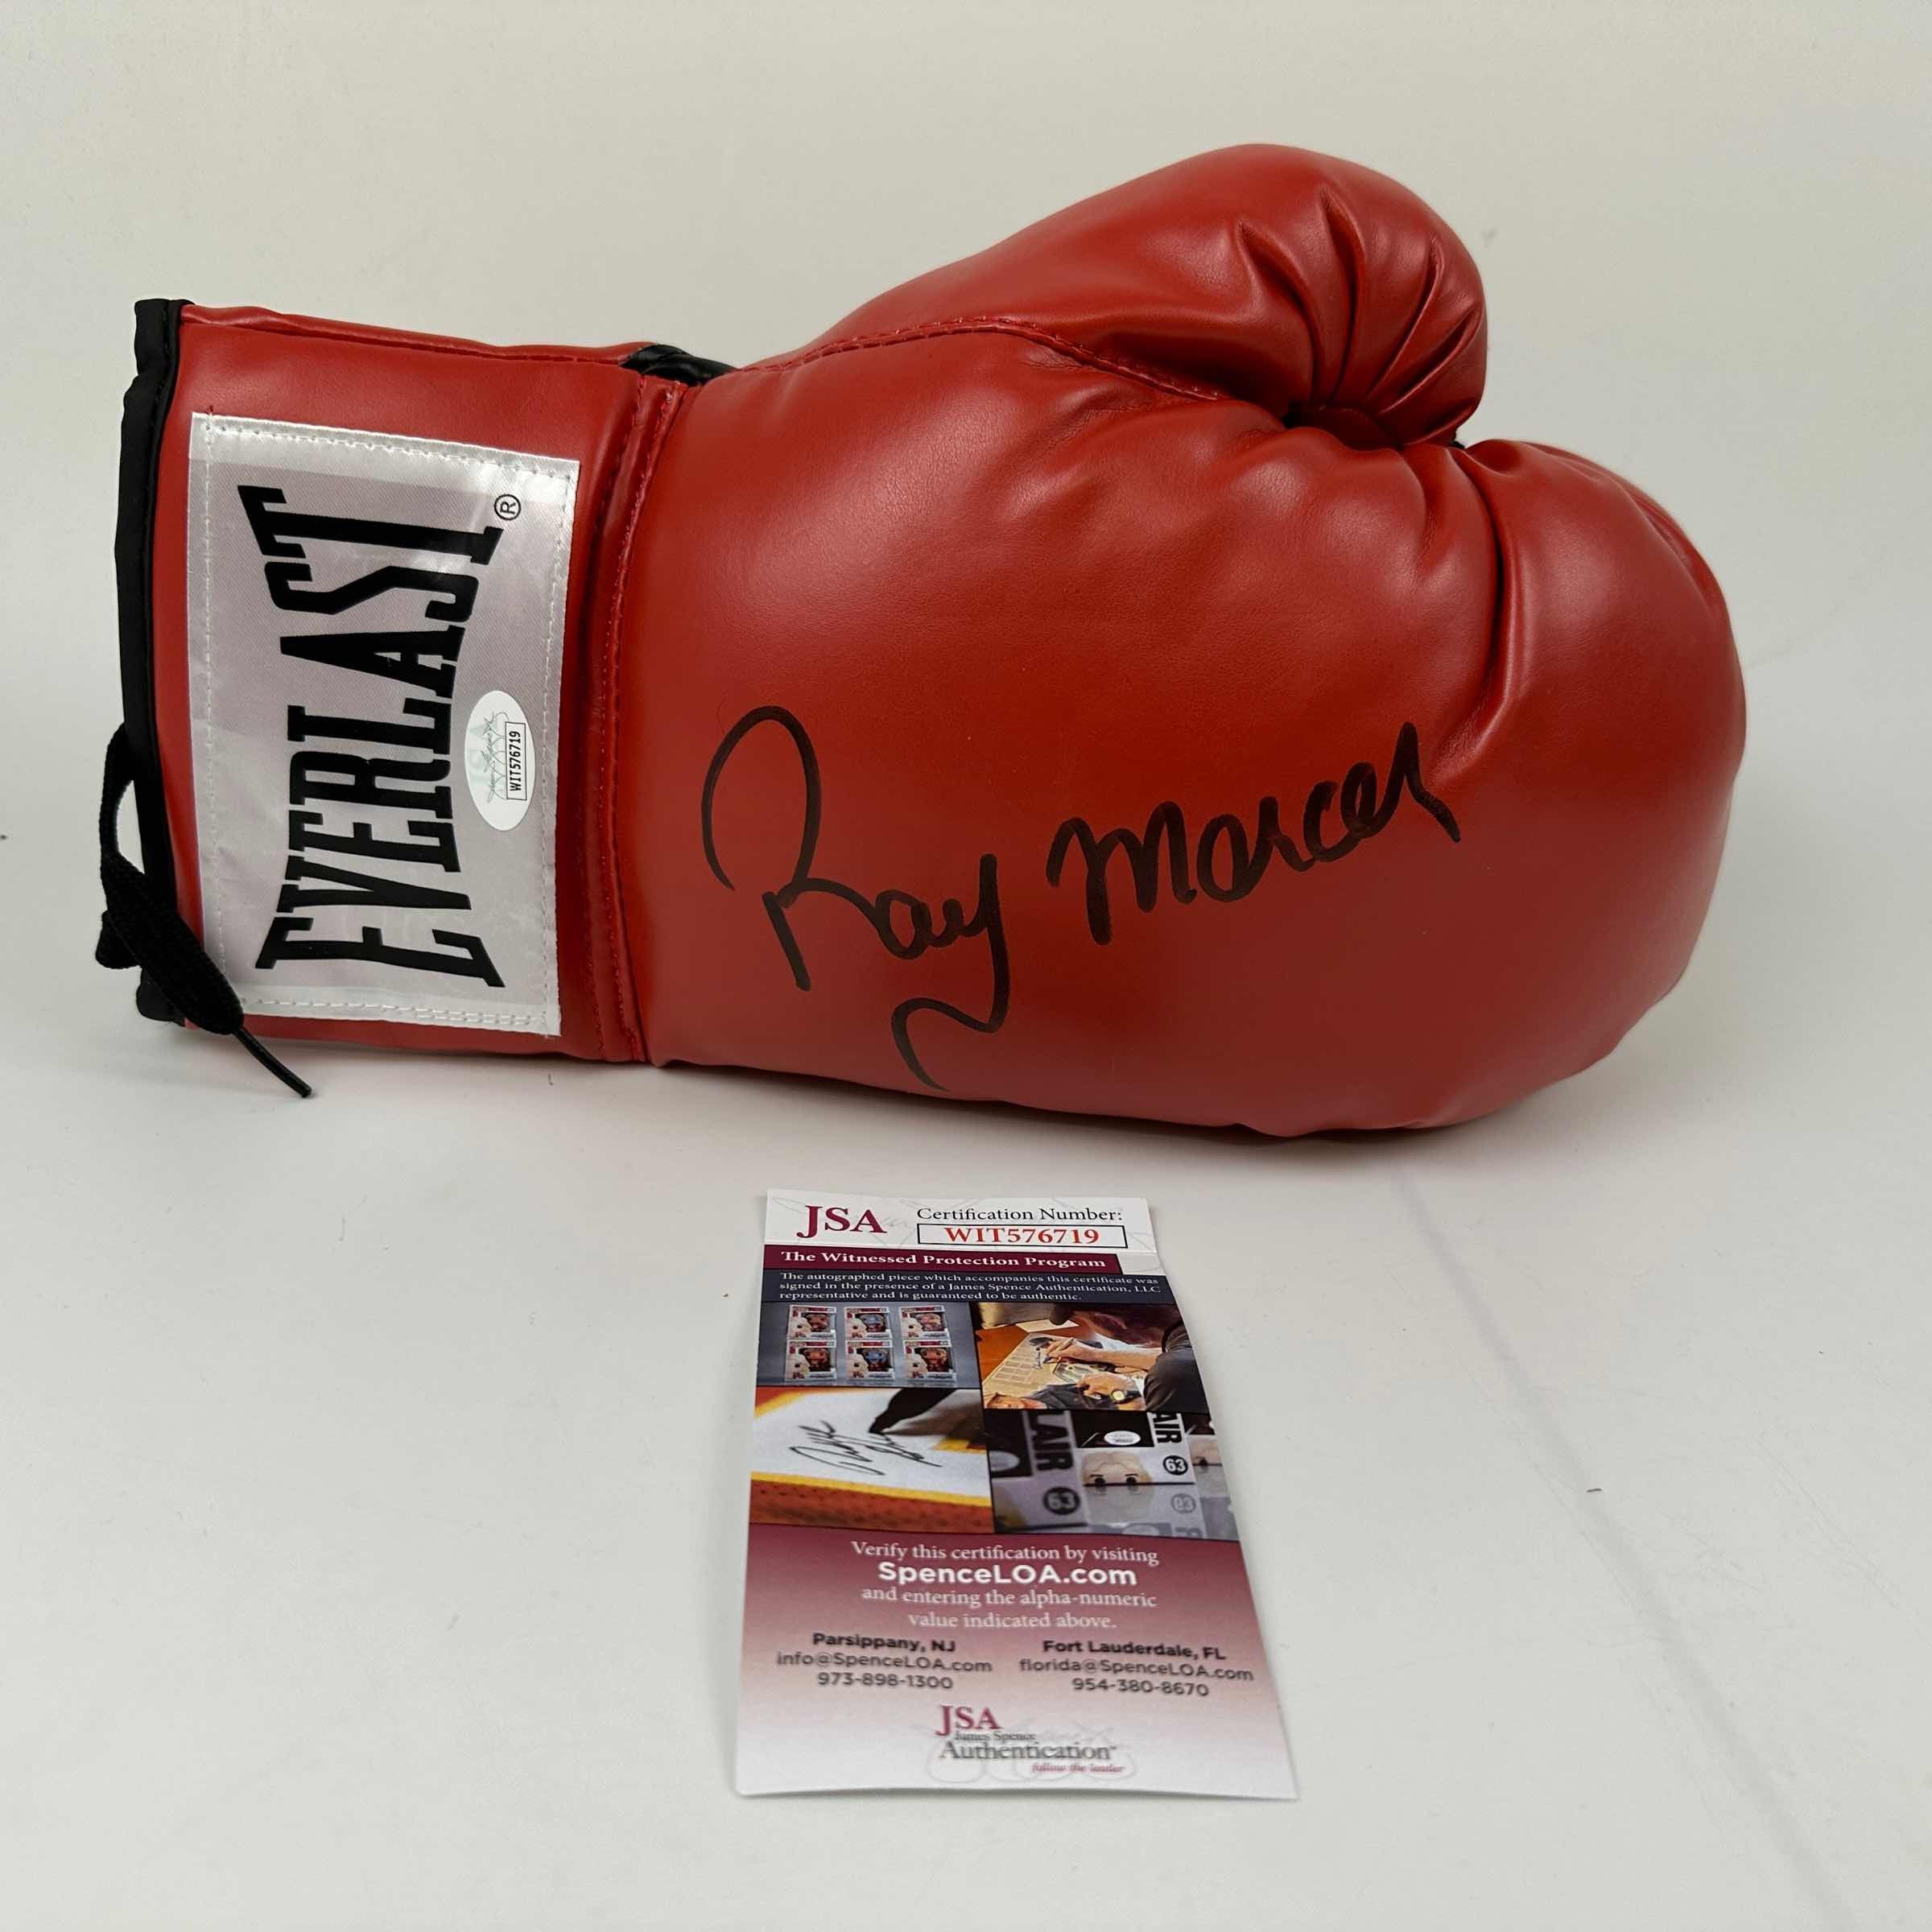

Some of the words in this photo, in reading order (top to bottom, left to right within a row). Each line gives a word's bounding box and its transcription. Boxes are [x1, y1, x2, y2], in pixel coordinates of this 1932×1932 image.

[237, 485, 506, 988] EVERLAST
[508, 730, 522, 791] WIT576719
[701, 705, 1011, 1092] Ray
[795, 1205, 888, 1239] JSA
[917, 1208, 1034, 1220] Certification
[1038, 1208, 1122, 1221] Number:
[944, 1227, 1100, 1245] WIT576719
[781, 1250, 815, 1262] The
[820, 1252, 917, 1265] Witnessed
[923, 1254, 1019, 1266] Protection
[1023, 1257, 1107, 1269] Program
[779, 1282, 821, 1291] signed
[865, 1284, 919, 1293] presence
[922, 1282, 937, 1290] of
[948, 1283, 985, 1291] James
[988, 1284, 1032, 1293] Spence
[1036, 1284, 1132, 1294] Authentication,
[780, 1272, 803, 1280] The
[807, 1273, 886, 1283] autographed
[889, 1274, 921, 1283] piece
[965, 1275, 1044, 1285] accompanies
[1046, 1275, 1070, 1284] this
[1072, 1276, 1133, 1285] certificate
[779, 1292, 869, 1301] representative
[872, 1291, 895, 1299] and
[899, 1291, 909, 1299] is
[912, 1292, 982, 1301] guaranteed
[986, 1292, 1001, 1300] to
[1005, 1292, 1018, 1300] be
[1021, 1292, 1083, 1301] authentic.
[852, 1540, 908, 1560] Verify
[912, 1544, 947, 1559] this
[952, 1545, 1059, 1560] certification
[1064, 1545, 1088, 1563] by
[1092, 1546, 1160, 1566] visiting
[877, 1562, 1137, 1586] SpenceLOA.com
[862, 1586, 897, 1601] and
[902, 1591, 981, 1608] entering
[985, 1589, 1015, 1604] the
[1020, 1590, 1159, 1608] alpha-numeric
[908, 1612, 960, 1628] value
[964, 1612, 1051, 1628] indicated
[1057, 1613, 1117, 1629] above.
[811, 1633, 926, 1653] Parsippany,
[931, 1640, 956, 1652] NJ
[1042, 1640, 1083, 1653] Fort
[1088, 1641, 1199, 1660] Lauderdale,
[1203, 1647, 1227, 1660] FL
[777, 1652, 993, 1673] info@SpenceLOA.com
[1018, 1657, 1254, 1681] florida@SpenceLOA.com
[818, 1672, 953, 1689] 973-898-1300
[1072, 1678, 1210, 1697] 954-380-8670
[935, 1704, 1002, 1736] JSA
